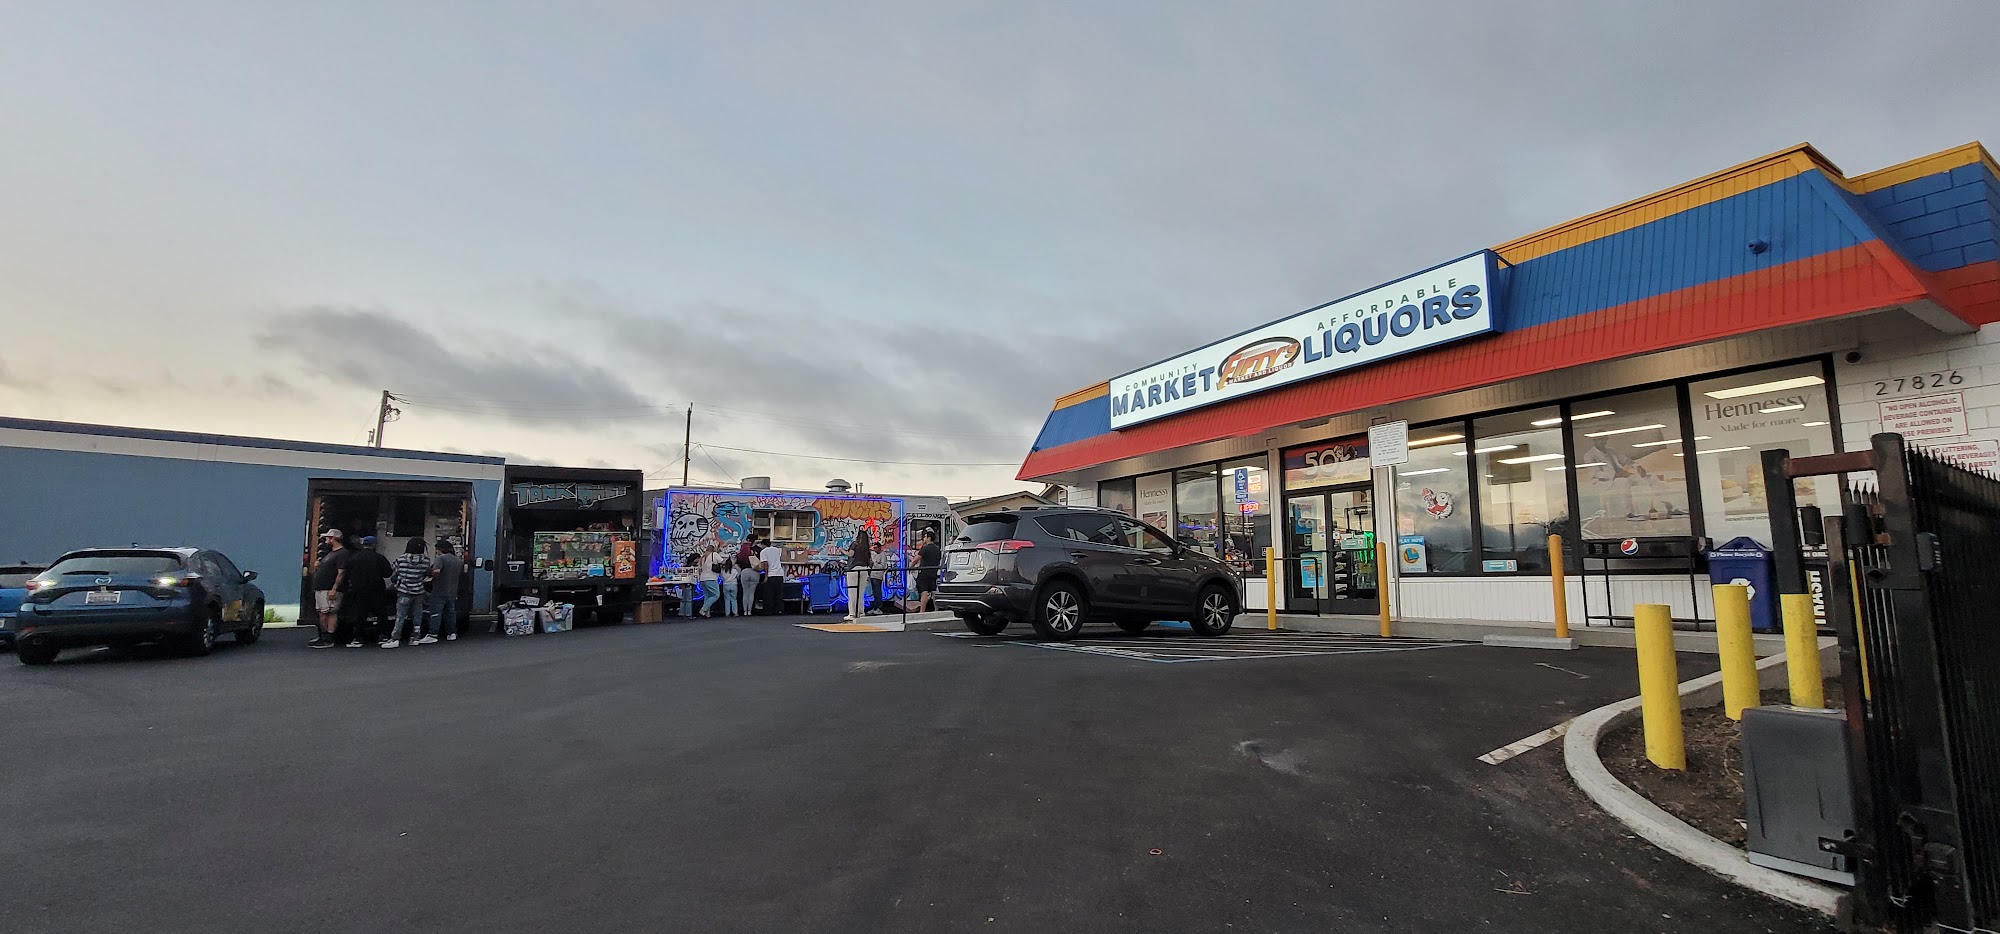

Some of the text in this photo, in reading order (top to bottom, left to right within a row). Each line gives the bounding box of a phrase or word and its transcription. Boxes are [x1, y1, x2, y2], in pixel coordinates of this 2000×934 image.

[1317, 278, 1456, 331] AFFORDABLE
[1303, 284, 1483, 364] LIQUORS
[1125, 363, 1198, 392] COMMUNITY
[1229, 374, 1252, 384] MARKET
[1268, 362, 1292, 373] LIQUOR
[1874, 370, 1963, 396] 27826
[1112, 366, 1216, 418] MARKET
[1704, 393, 1811, 421] Hennessy
[1883, 406, 1963, 421] BEVERAGE CONTAINERS
[1899, 402, 1917, 410] OPEN
[1918, 397, 1957, 407] ALCOHOLIC
[1720, 417, 1800, 432] Made for more
[1895, 416, 1953, 429] ARE ALLOWED ON
[1956, 451, 1997, 460] BEVERAGES
[1140, 488, 1168, 498] Hennessy
